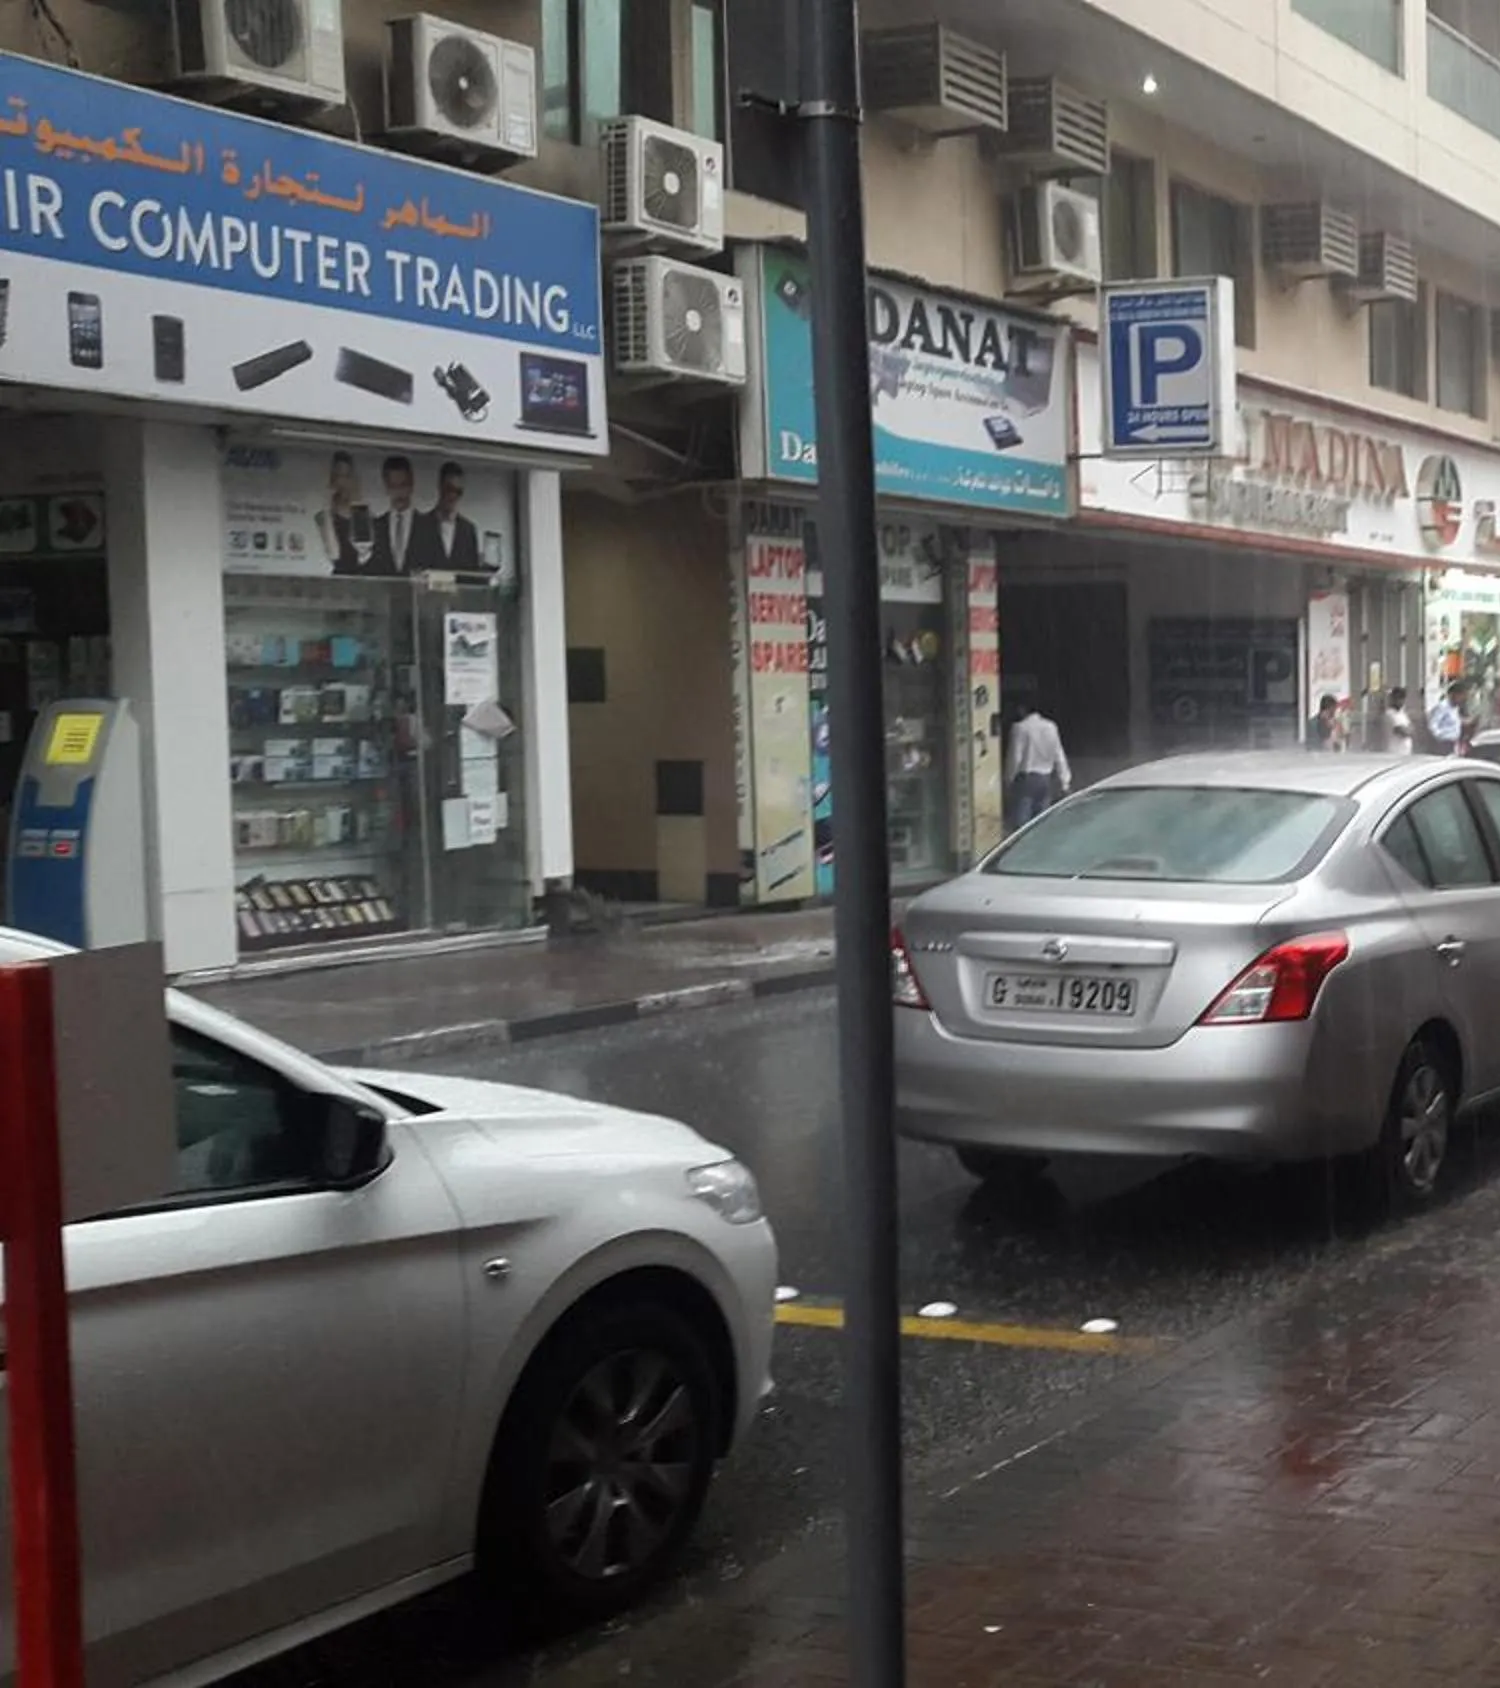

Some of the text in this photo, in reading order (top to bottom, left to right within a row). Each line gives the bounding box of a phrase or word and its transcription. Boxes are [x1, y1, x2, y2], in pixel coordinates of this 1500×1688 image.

[0, 95, 204, 174] الكمبيوت
[222, 150, 364, 213] لتجارة
[4, 168, 65, 239] IR
[89, 190, 372, 297] COMPUTER
[386, 250, 570, 334] TRADING
[868, 285, 1039, 378] DANAT
[1138, 324, 1202, 405] P
[780, 430, 818, 465] Da
[1260, 409, 1412, 500] MADINA
[747, 543, 807, 579] LAPTOP
[749, 592, 808, 625] SERVICE
[751, 640, 809, 673] SPARE
[1057, 976, 1133, 1012] 19209
